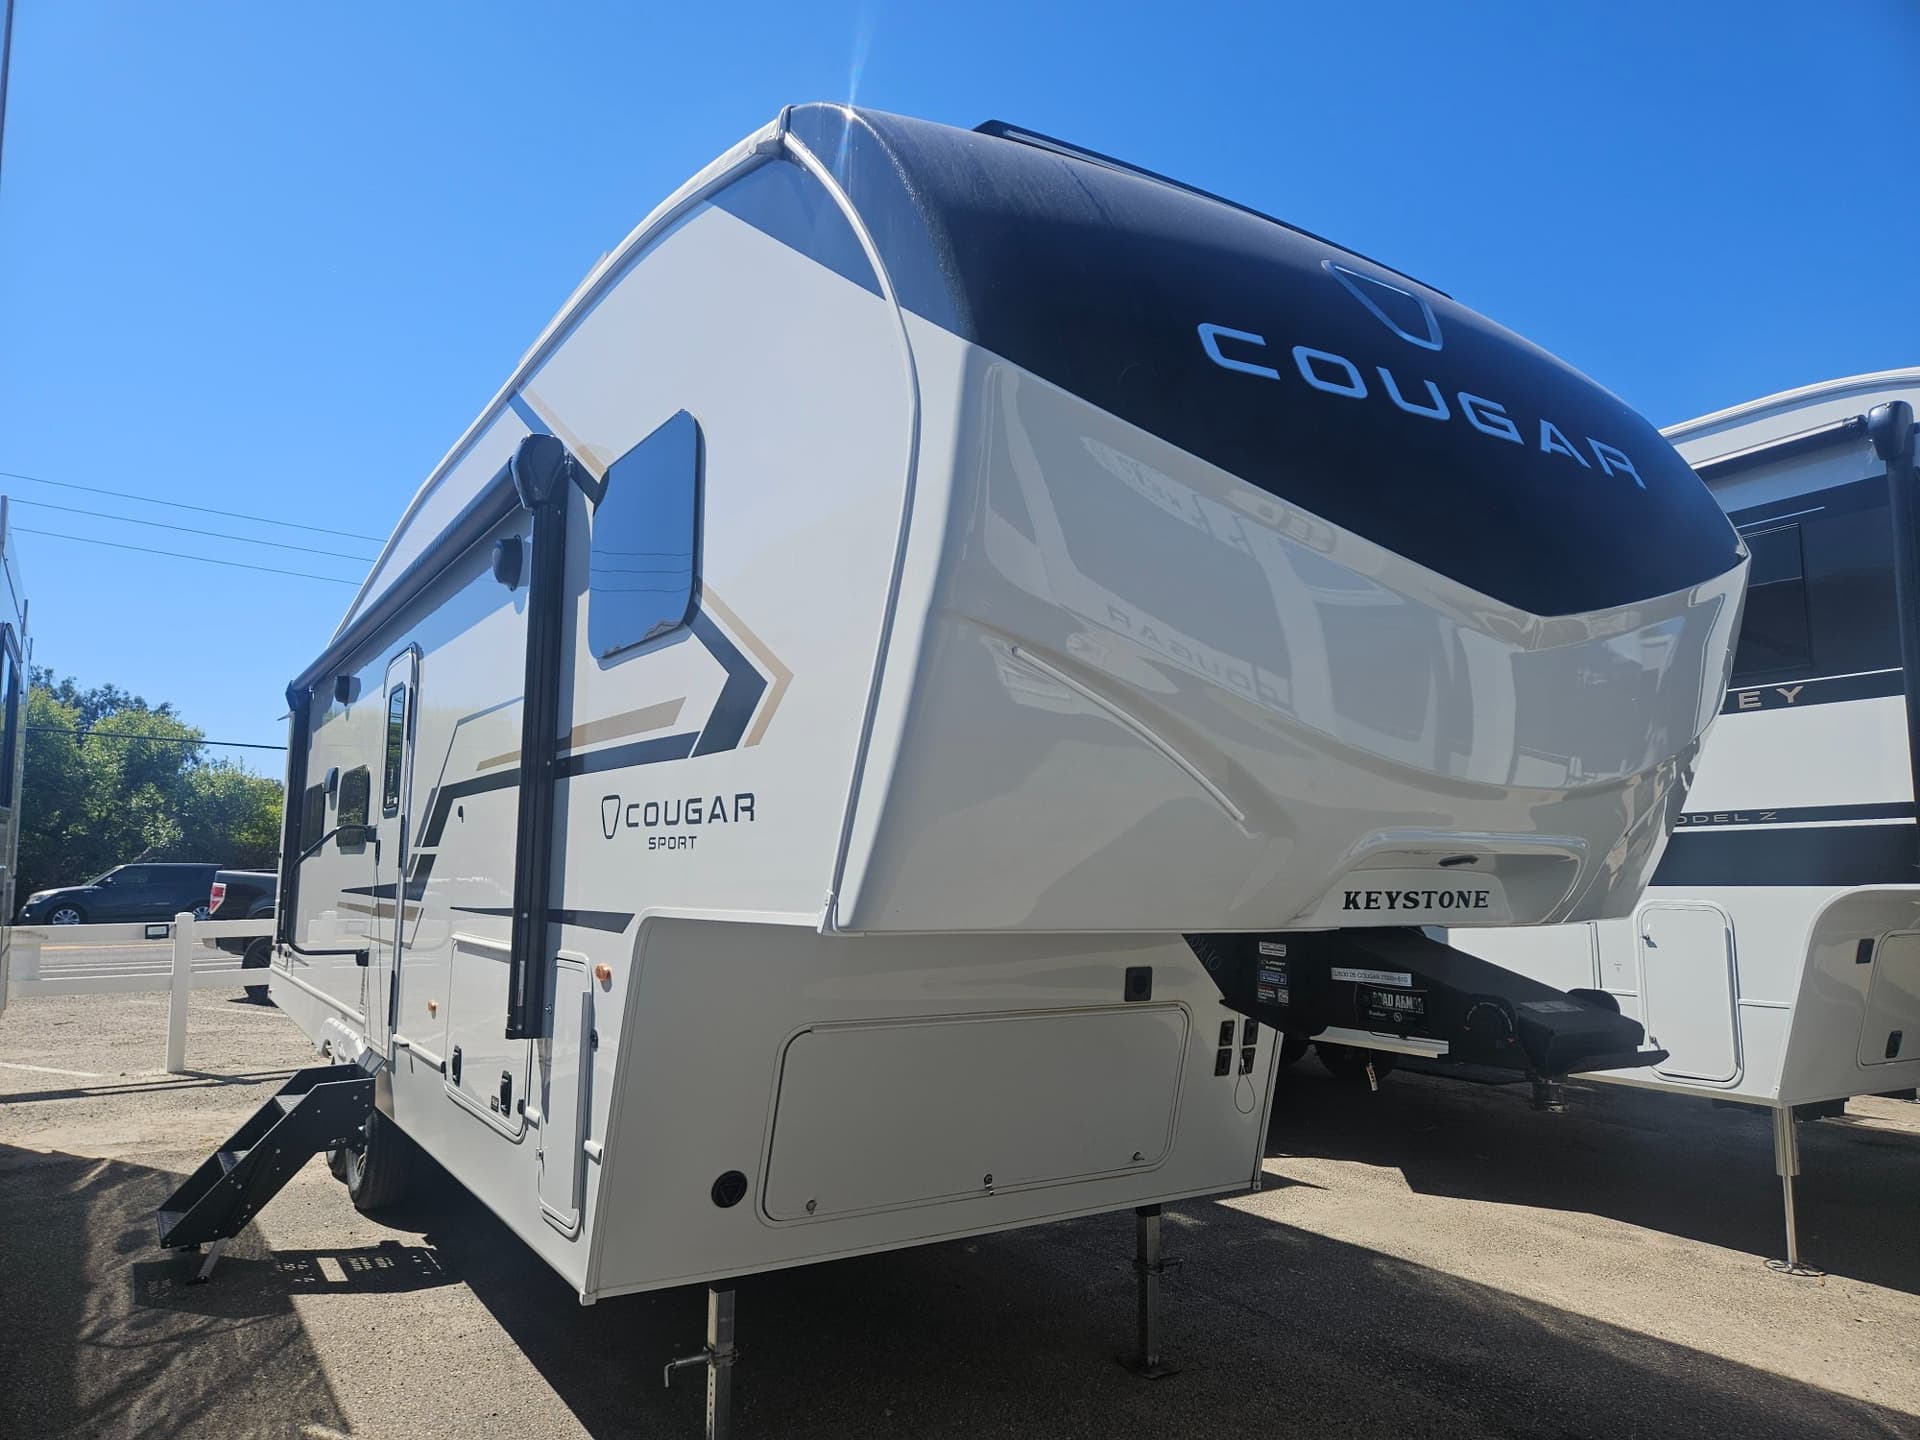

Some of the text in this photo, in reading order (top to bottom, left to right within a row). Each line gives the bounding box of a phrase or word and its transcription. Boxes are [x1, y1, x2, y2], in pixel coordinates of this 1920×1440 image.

[1196, 322, 1647, 490] COUGAR
[625, 792, 755, 828] COUGAR
[1759, 811, 1777, 821] Z
[648, 835, 698, 850] SPORT
[1342, 890, 1490, 910] KEYSTONE
